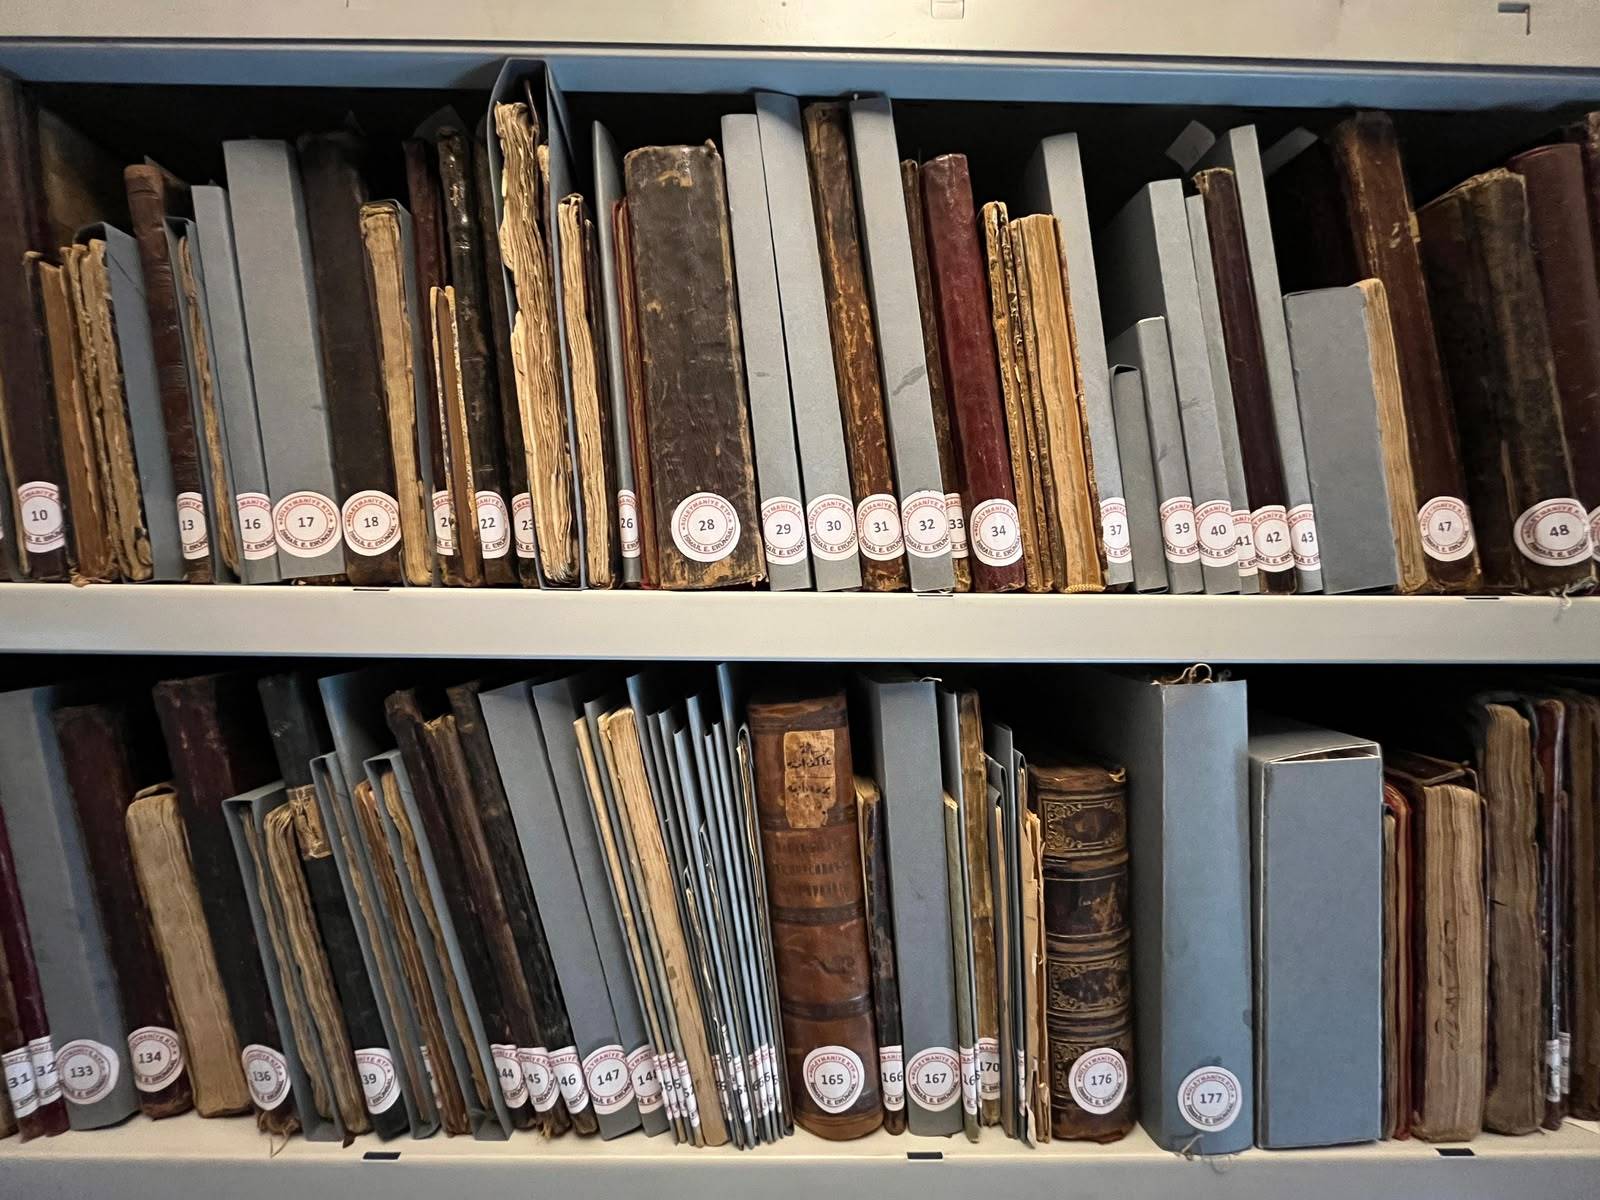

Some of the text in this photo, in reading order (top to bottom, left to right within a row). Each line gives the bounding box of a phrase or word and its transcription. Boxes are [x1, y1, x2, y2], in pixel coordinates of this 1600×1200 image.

[32, 509, 48, 522] 10
[181, 519, 194, 531] 13
[244, 518, 261, 530] 16
[297, 516, 314, 528] 17
[364, 516, 379, 528] 18
[480, 517, 496, 529] 22
[620, 517, 633, 529] 26
[698, 518, 715, 531] 28
[826, 520, 842, 532] 30
[873, 521, 889, 533] 31
[919, 518, 936, 531] 32
[949, 518, 964, 530] 33
[1438, 521, 1452, 532] 47
[776, 523, 791, 535] 29
[991, 525, 1007, 537] 34
[1109, 524, 1122, 536] 37
[1174, 522, 1190, 535] 39
[1210, 524, 1227, 536] 40
[1549, 524, 1570, 537] 48
[1235, 535, 1252, 547] 41
[1266, 531, 1282, 543] 42
[1301, 531, 1314, 543] 43
[139, 1051, 162, 1064] 134
[36, 1061, 56, 1077] 32
[70, 1065, 94, 1078] 133
[980, 1061, 1000, 1073] 170
[8, 1071, 31, 1089] 31
[253, 1070, 271, 1082] 136
[362, 1073, 377, 1085] 39
[527, 1072, 541, 1084] 45
[560, 1073, 577, 1087] 46
[598, 1068, 620, 1086] 147
[821, 1074, 844, 1085] 165
[882, 1071, 904, 1083] 166
[924, 1072, 947, 1084] 167
[962, 1072, 975, 1086] 16
[1091, 1073, 1112, 1086] 176
[1200, 1092, 1223, 1104] 177
